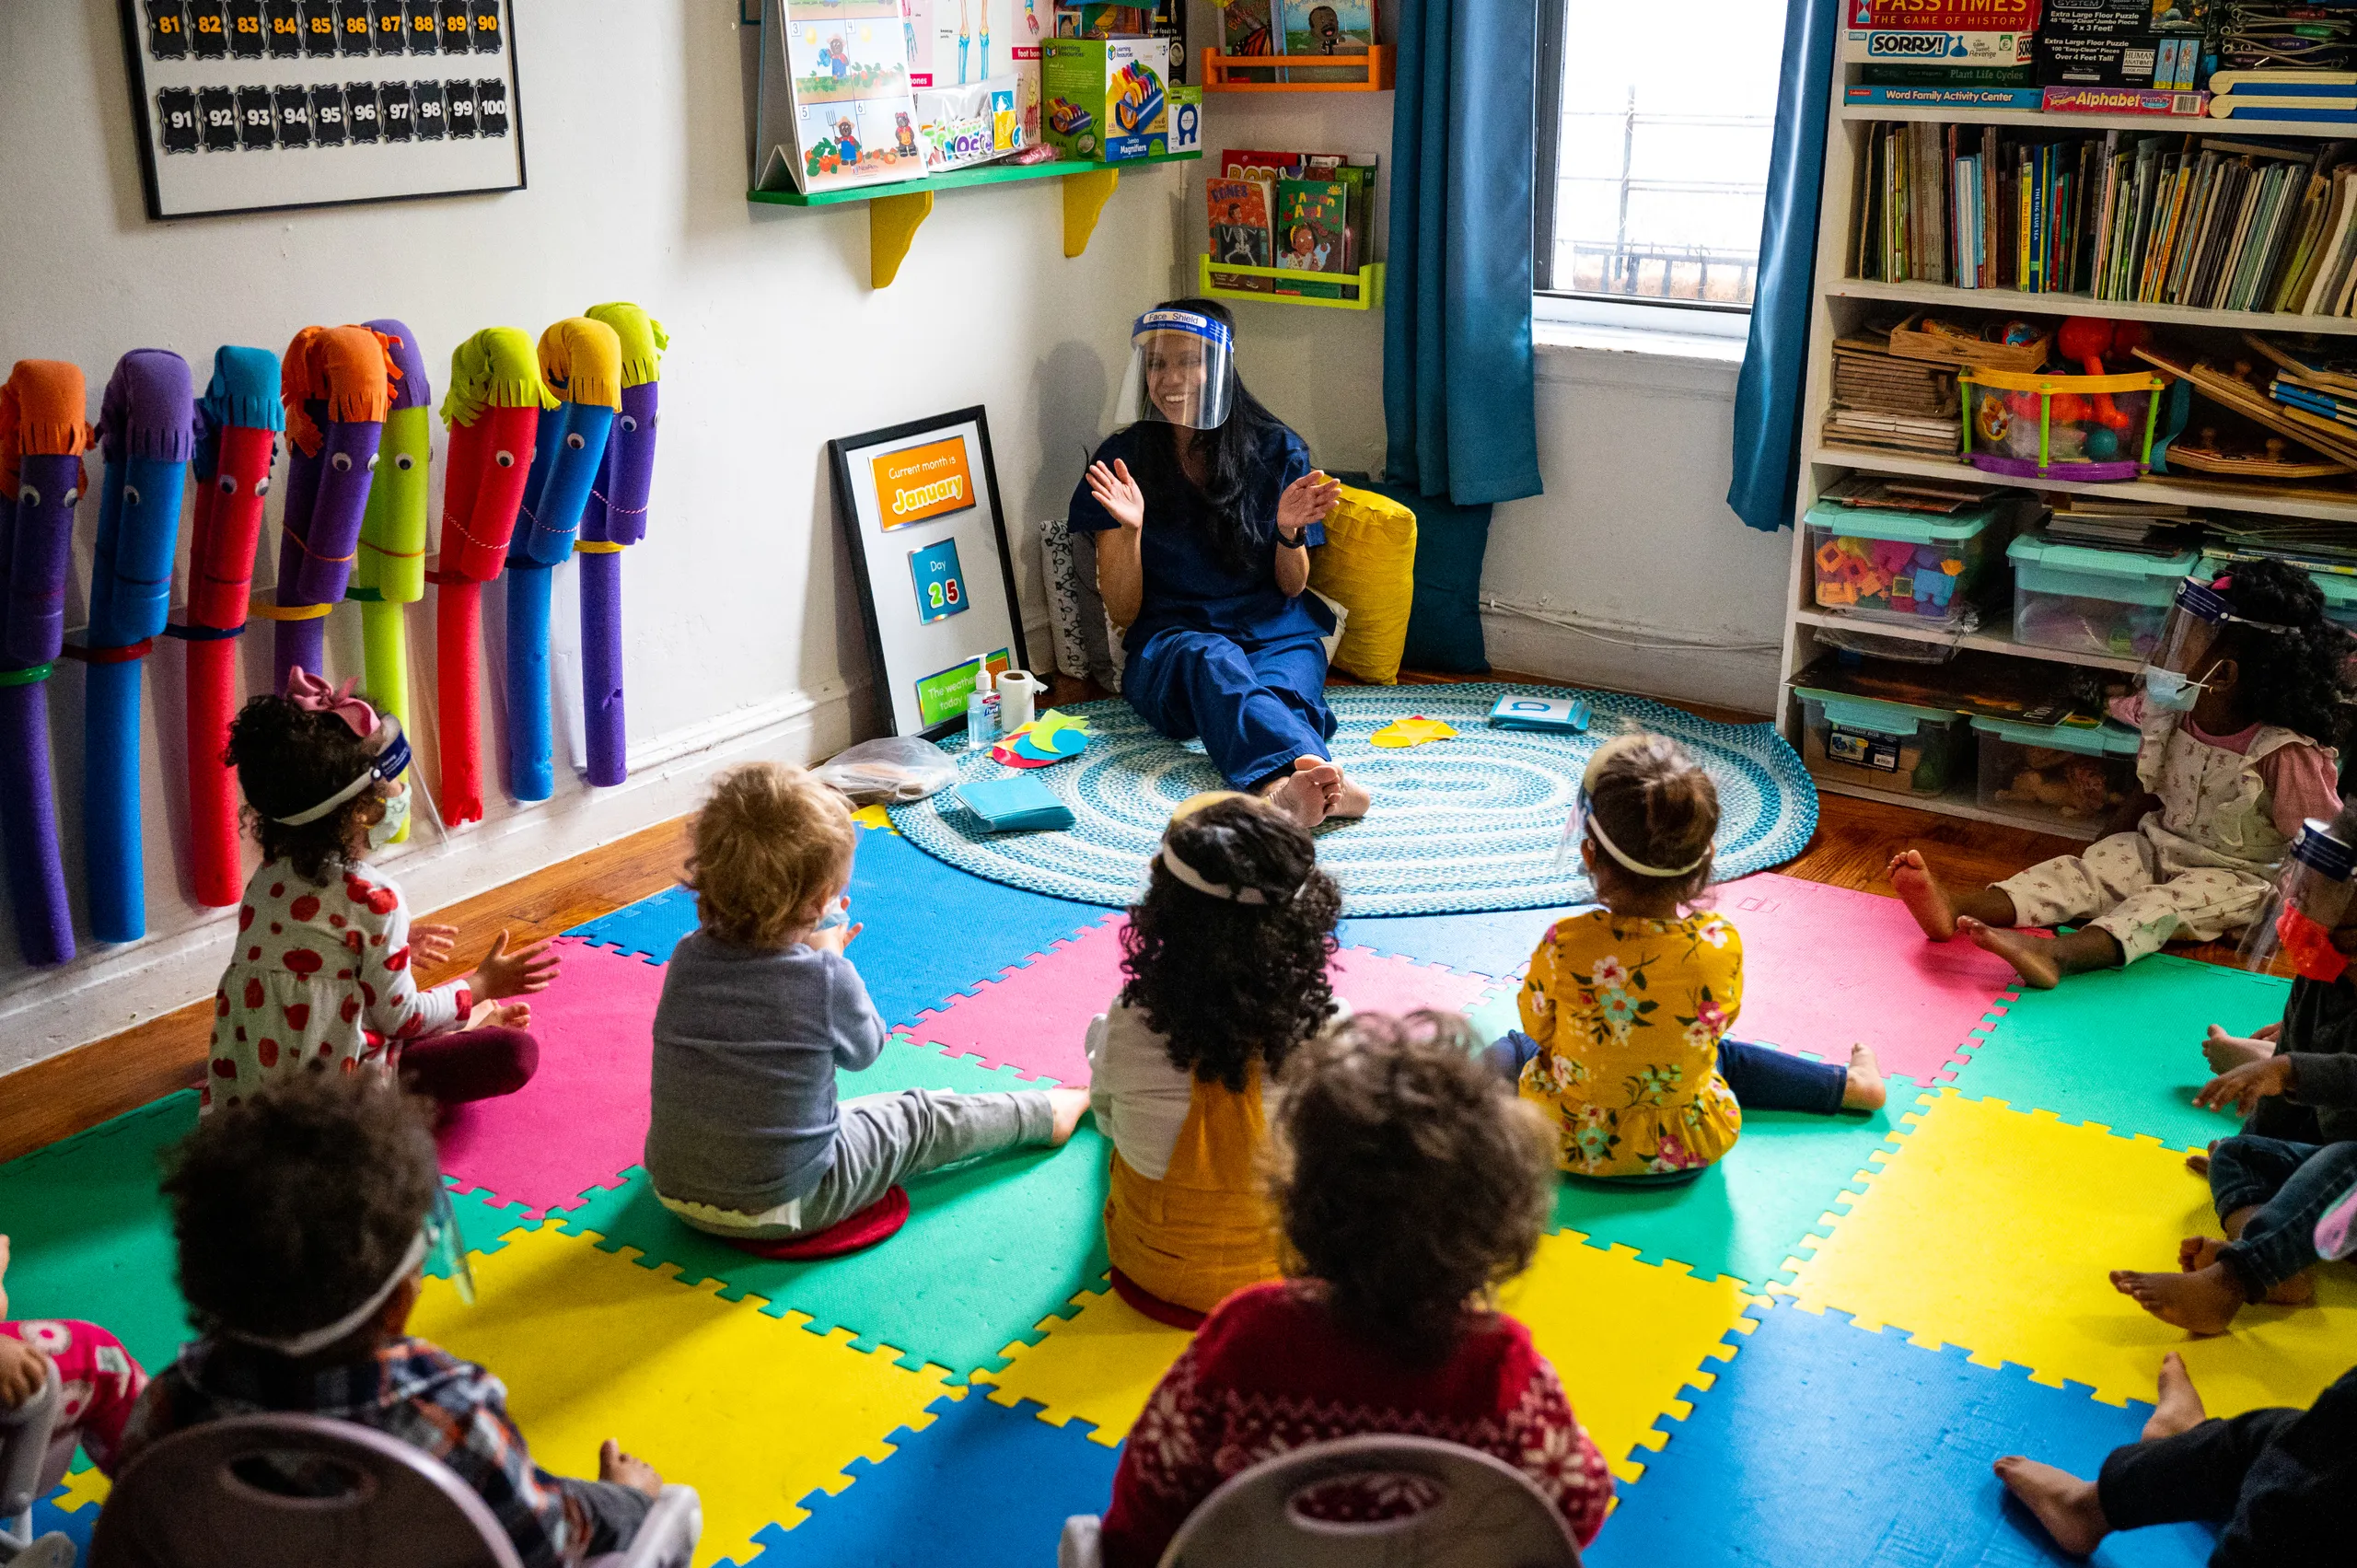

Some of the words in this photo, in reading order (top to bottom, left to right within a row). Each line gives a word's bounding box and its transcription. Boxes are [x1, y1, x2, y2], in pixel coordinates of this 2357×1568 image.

[2072, 11, 2094, 19] Large
[159, 17, 180, 33] 81
[199, 16, 221, 33] 82
[238, 17, 259, 33] 83
[274, 17, 296, 34] 84
[311, 18, 331, 33] 85
[347, 17, 366, 33] 86
[381, 17, 401, 31] 87
[414, 17, 434, 31] 88
[447, 17, 466, 31] 89
[478, 16, 497, 30] 90
[847, 22, 853, 30] 4
[1875, 16, 1897, 24] THE
[1904, 16, 1937, 24] GAME
[1945, 17, 1960, 25] OF
[1968, 16, 2026, 26] HISTORY
[794, 24, 799, 33] 3
[1874, 35, 1943, 52] SORRY!
[2065, 39, 2084, 47] Large
[1018, 49, 1028, 57] foot
[2125, 52, 2154, 60] HUMAN
[1950, 70, 1973, 79] Plant
[1976, 70, 1994, 79] Life
[1996, 70, 2024, 81] Cycles
[1886, 90, 1911, 99] Word
[1913, 90, 1942, 102] Family
[1944, 91, 1979, 102] Activity
[1981, 92, 2013, 101] Center
[2075, 92, 2140, 107] Alphabet
[802, 107, 807, 117] 5
[858, 103, 863, 112] 6
[171, 111, 192, 128] 91
[210, 109, 233, 126] 92
[247, 110, 270, 126] 93
[284, 108, 308, 124] 94
[320, 107, 341, 122] 95
[354, 105, 376, 120] 96
[389, 104, 408, 119] 97
[422, 102, 440, 117] 98
[453, 101, 472, 116] 99
[482, 100, 506, 115] 100
[1120, 144, 1146, 155] Magnifiers
[1149, 313, 1167, 321] Face
[1173, 312, 1199, 324] Shield
[889, 463, 920, 480] Current
[923, 456, 948, 471] month
[949, 455, 956, 464] is
[892, 475, 963, 516] January
[930, 561, 946, 572] Day
[928, 687, 944, 700] The
[940, 695, 962, 710] today
